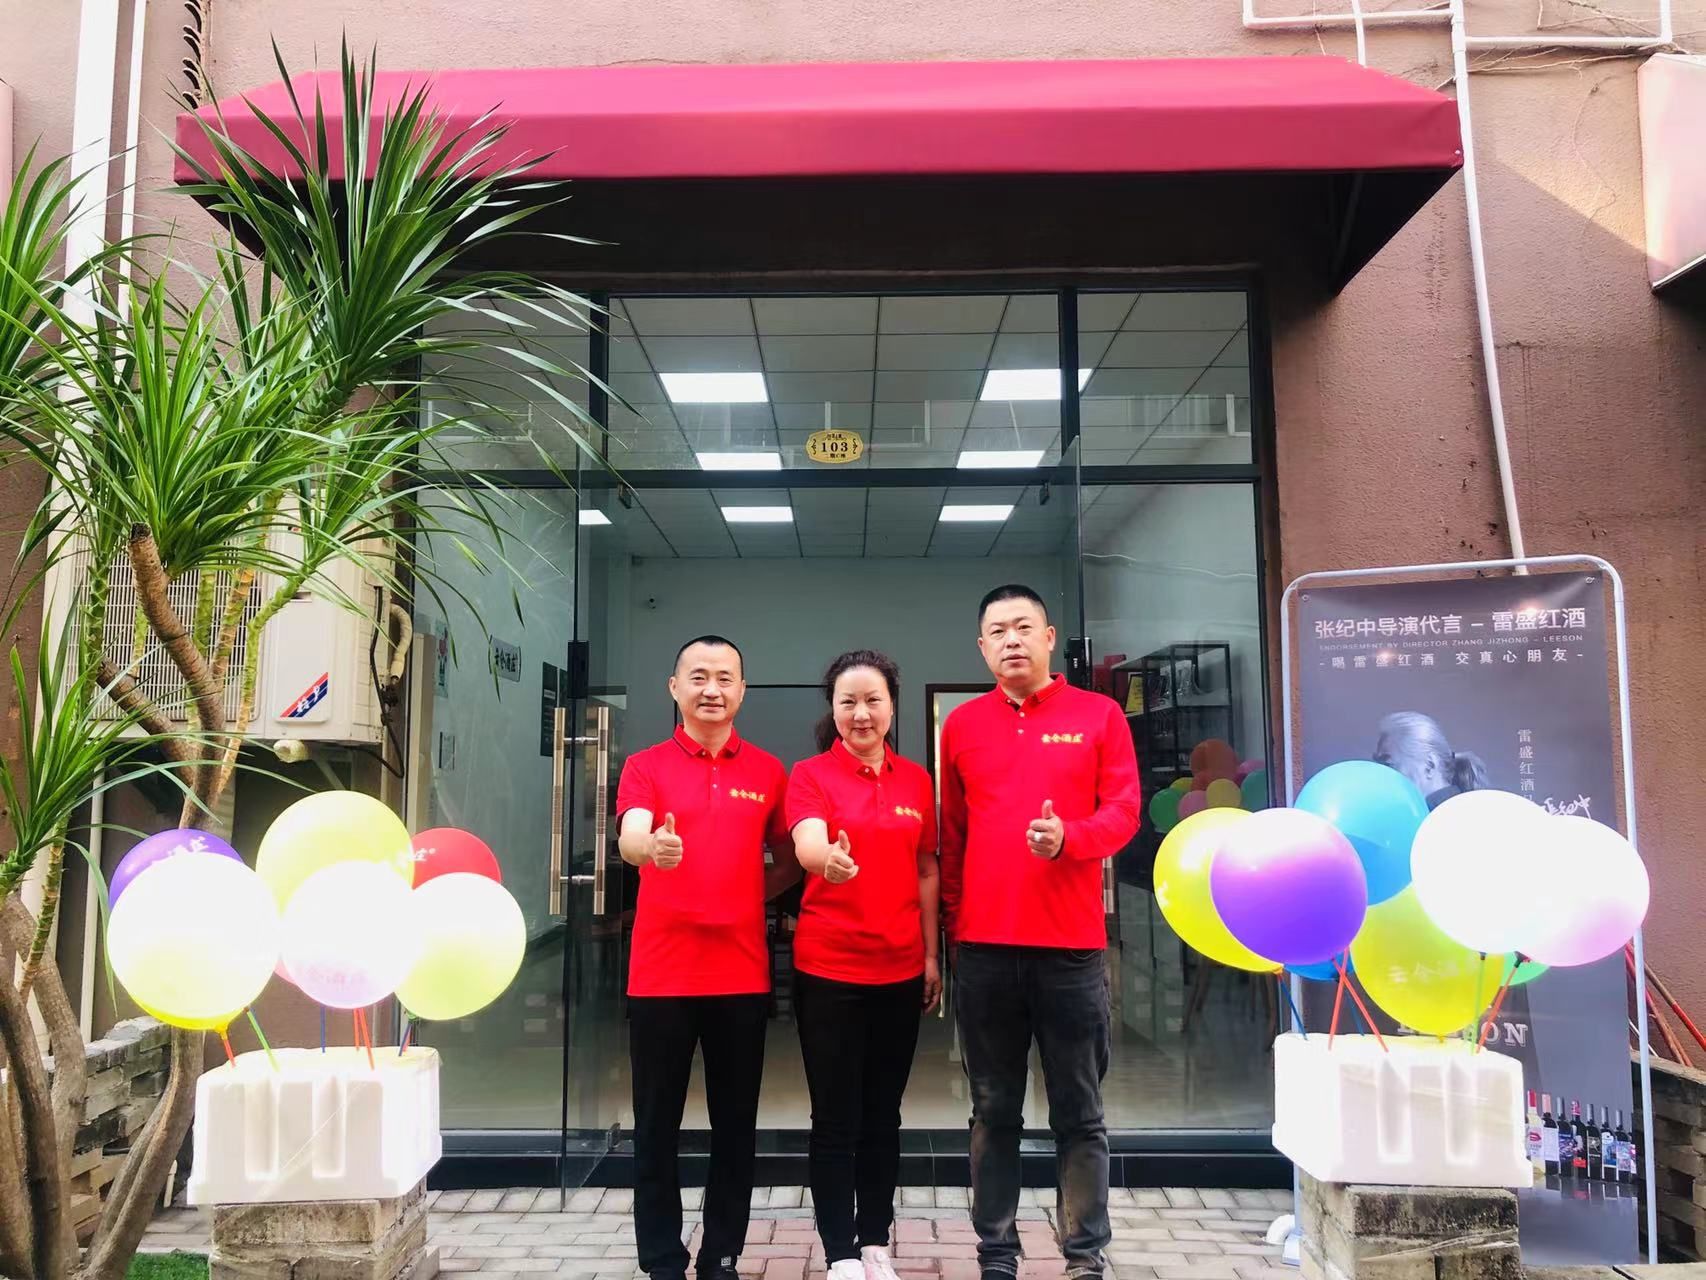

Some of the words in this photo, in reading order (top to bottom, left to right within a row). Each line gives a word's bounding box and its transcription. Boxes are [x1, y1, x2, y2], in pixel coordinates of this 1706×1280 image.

[821, 442, 848, 452] 103
[1315, 614, 1462, 639] 张纪中导演代言
[1492, 607, 1586, 632] 雷盛红酒
[1402, 640, 1448, 649] DIRECTOR
[1451, 638, 1483, 647] ZHANG
[1487, 636, 1529, 645] JIZHONG
[1543, 634, 1583, 643] LEESON
[1455, 648, 1567, 665] 交真心朋友
